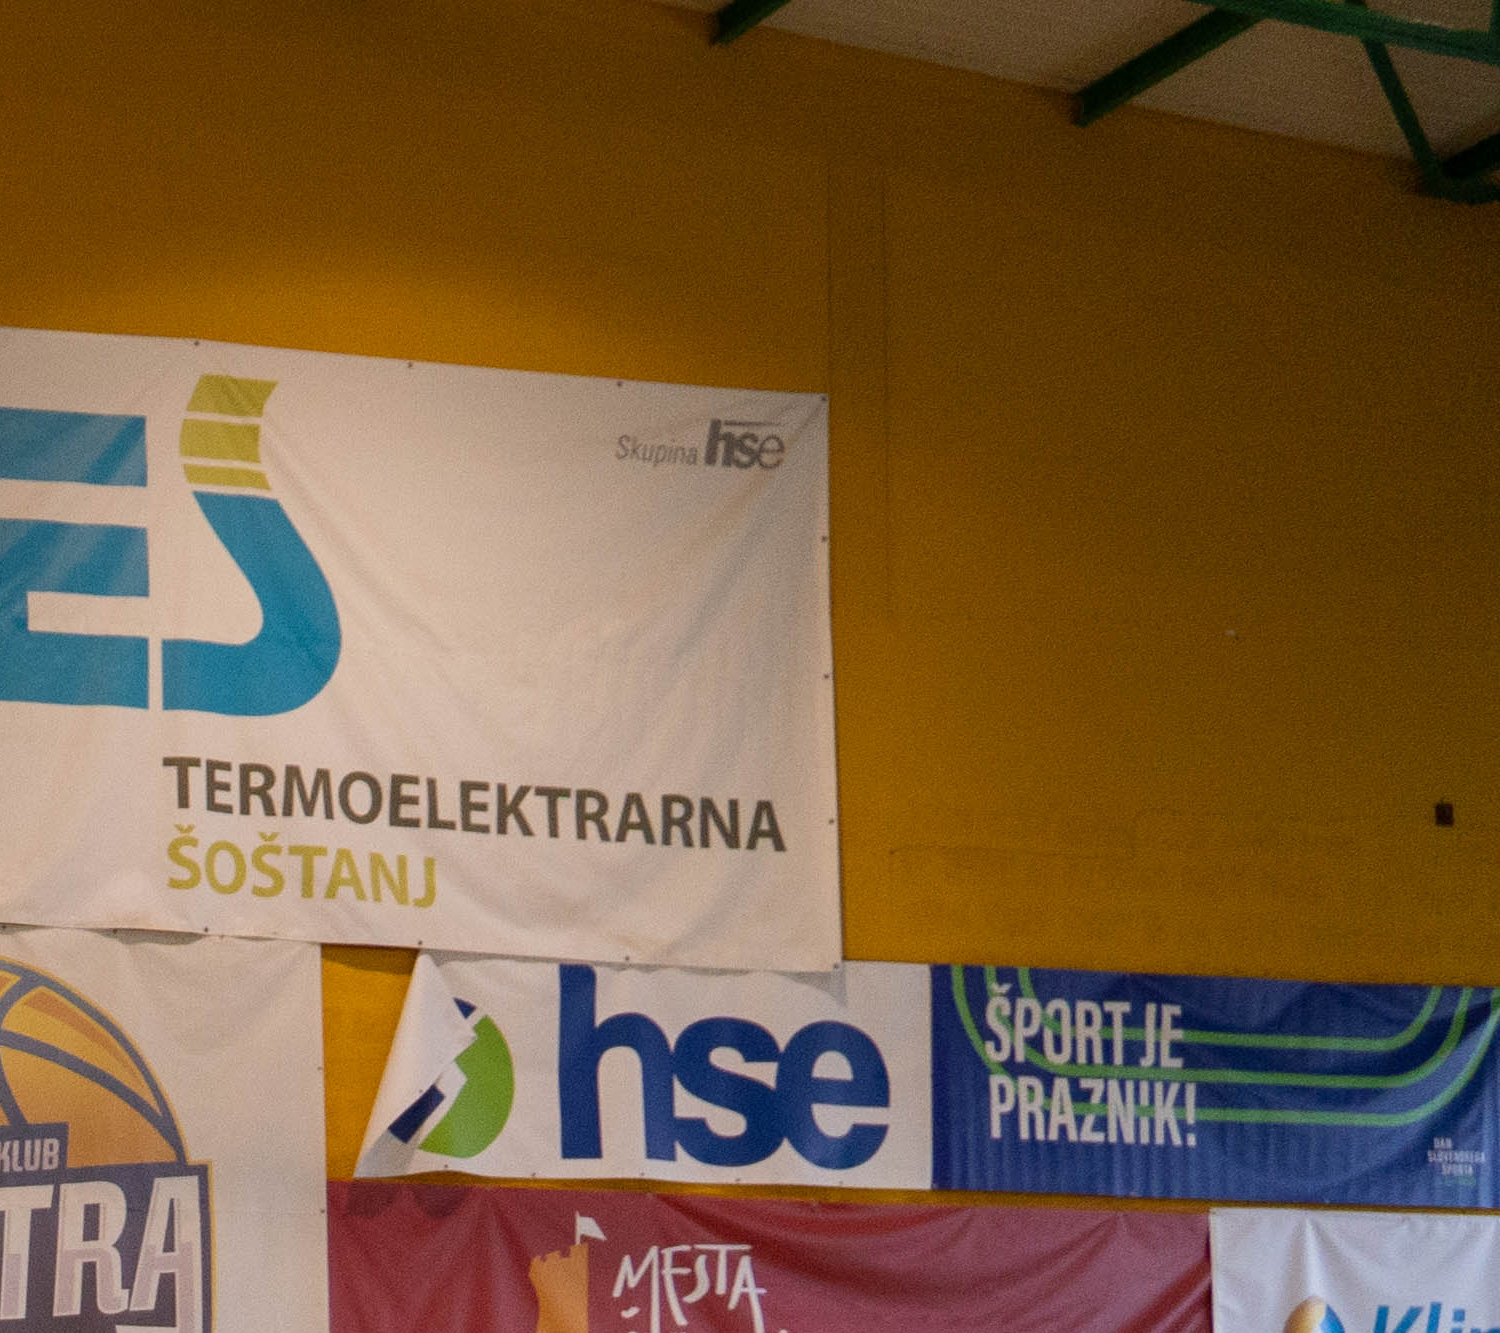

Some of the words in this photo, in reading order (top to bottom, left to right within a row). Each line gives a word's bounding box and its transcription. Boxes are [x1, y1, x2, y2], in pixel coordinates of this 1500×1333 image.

[616, 434, 699, 467] Skupina
[704, 418, 786, 470] hse
[162, 755, 788, 855] TERMOELEKTRARNA
[164, 825, 440, 910] ŠOŠTANJ
[557, 962, 892, 1171] hse
[984, 982, 1132, 1066] ŠPORT
[1139, 1002, 1185, 1069] JE
[988, 1073, 1198, 1149] PRAZNIK!
